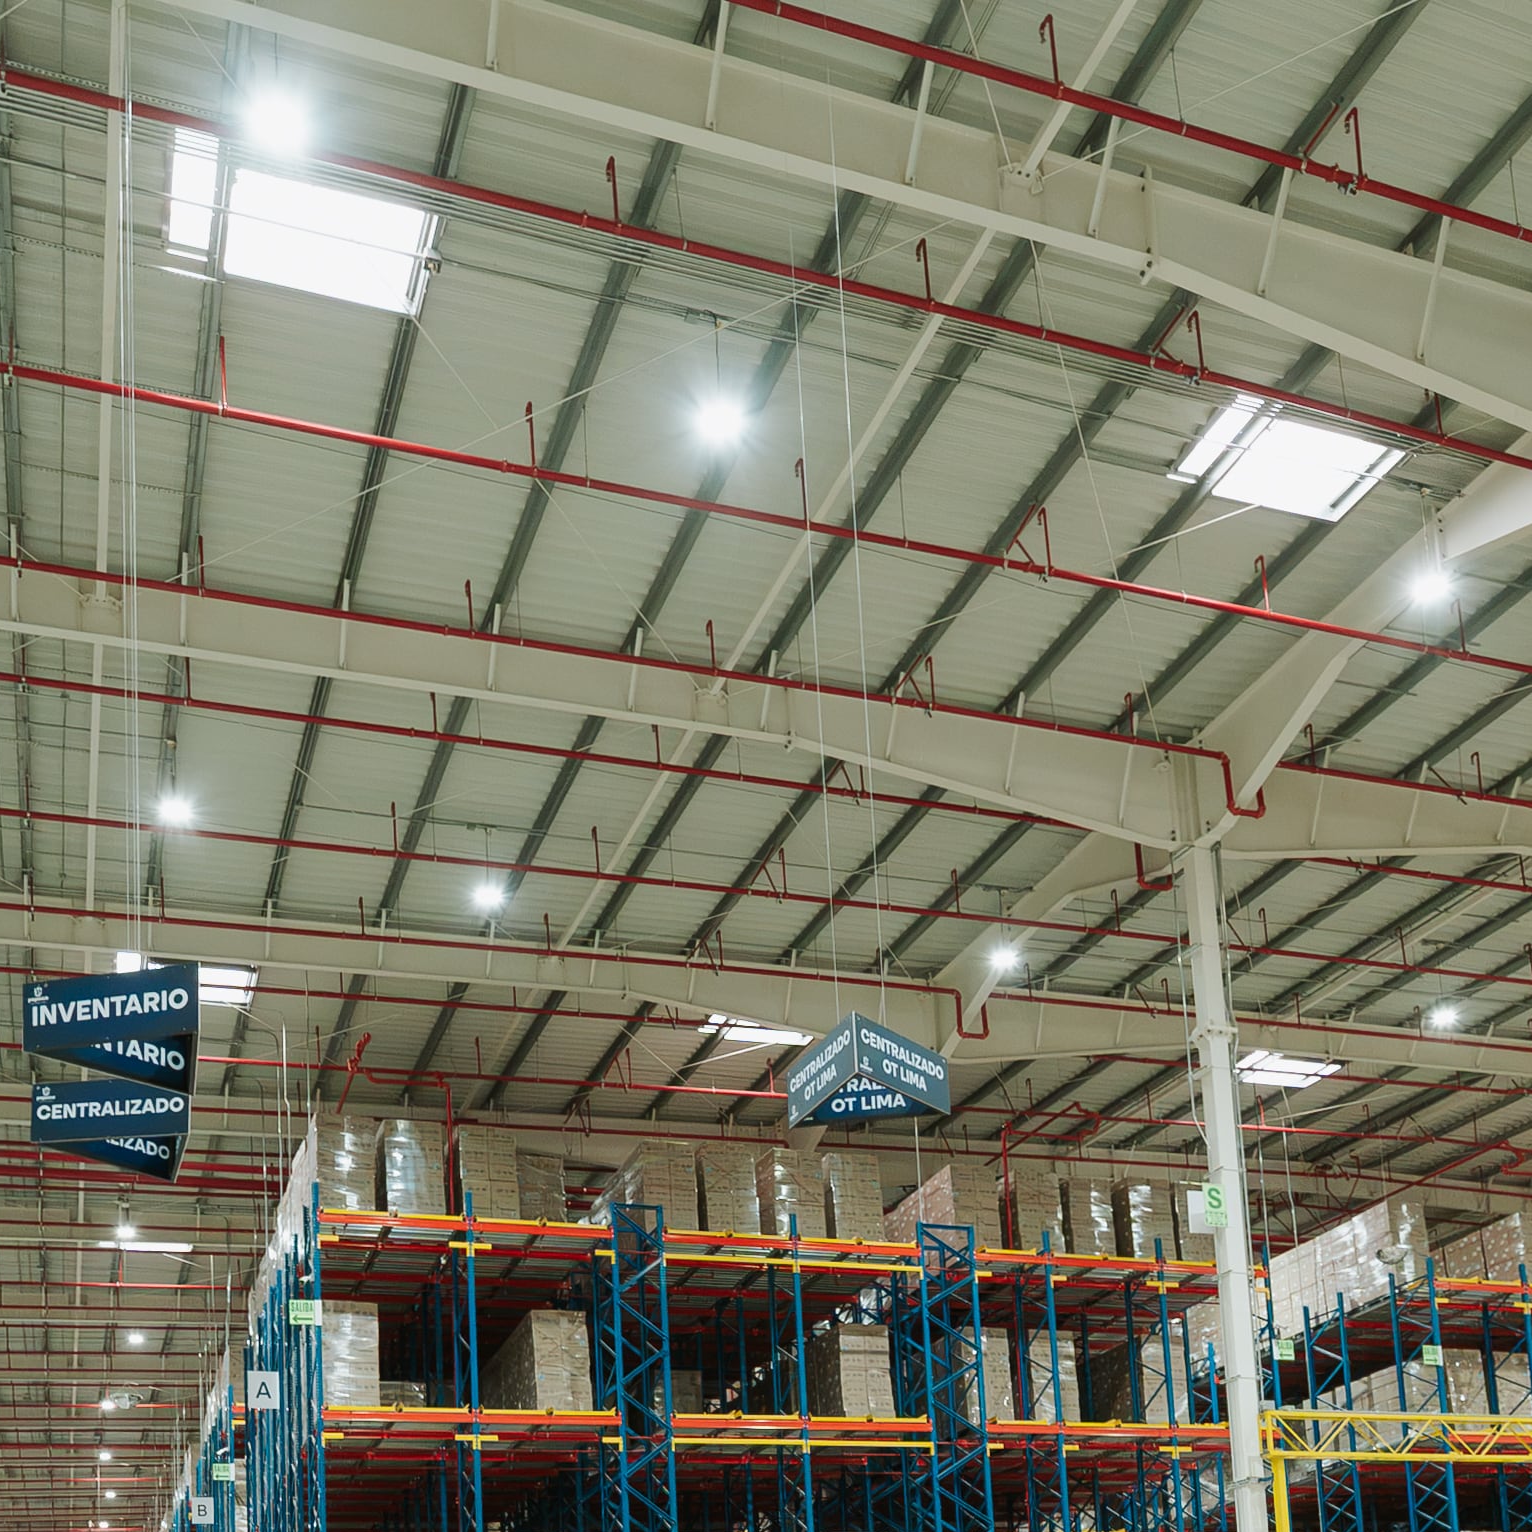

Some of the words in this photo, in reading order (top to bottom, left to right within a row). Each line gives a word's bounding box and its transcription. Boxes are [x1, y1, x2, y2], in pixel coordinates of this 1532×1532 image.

[31, 988, 189, 1027] INVENTARIO
[789, 1030, 851, 1092] CENTRALIZADO
[859, 1028, 945, 1080] CENTRALIZADO
[804, 1083, 816, 1101] OT
[816, 1064, 838, 1094] LIMA
[882, 1059, 899, 1080] OT
[899, 1070, 928, 1092] LIMA
[36, 1096, 185, 1121] CENTRALIZADO
[831, 1097, 857, 1113] OT
[860, 1093, 907, 1111] LIMA
[1207, 1187, 1222, 1209] S
[290, 1301, 314, 1313] SALIDA
[256, 1381, 272, 1399] A
[197, 1504, 208, 1517] B
